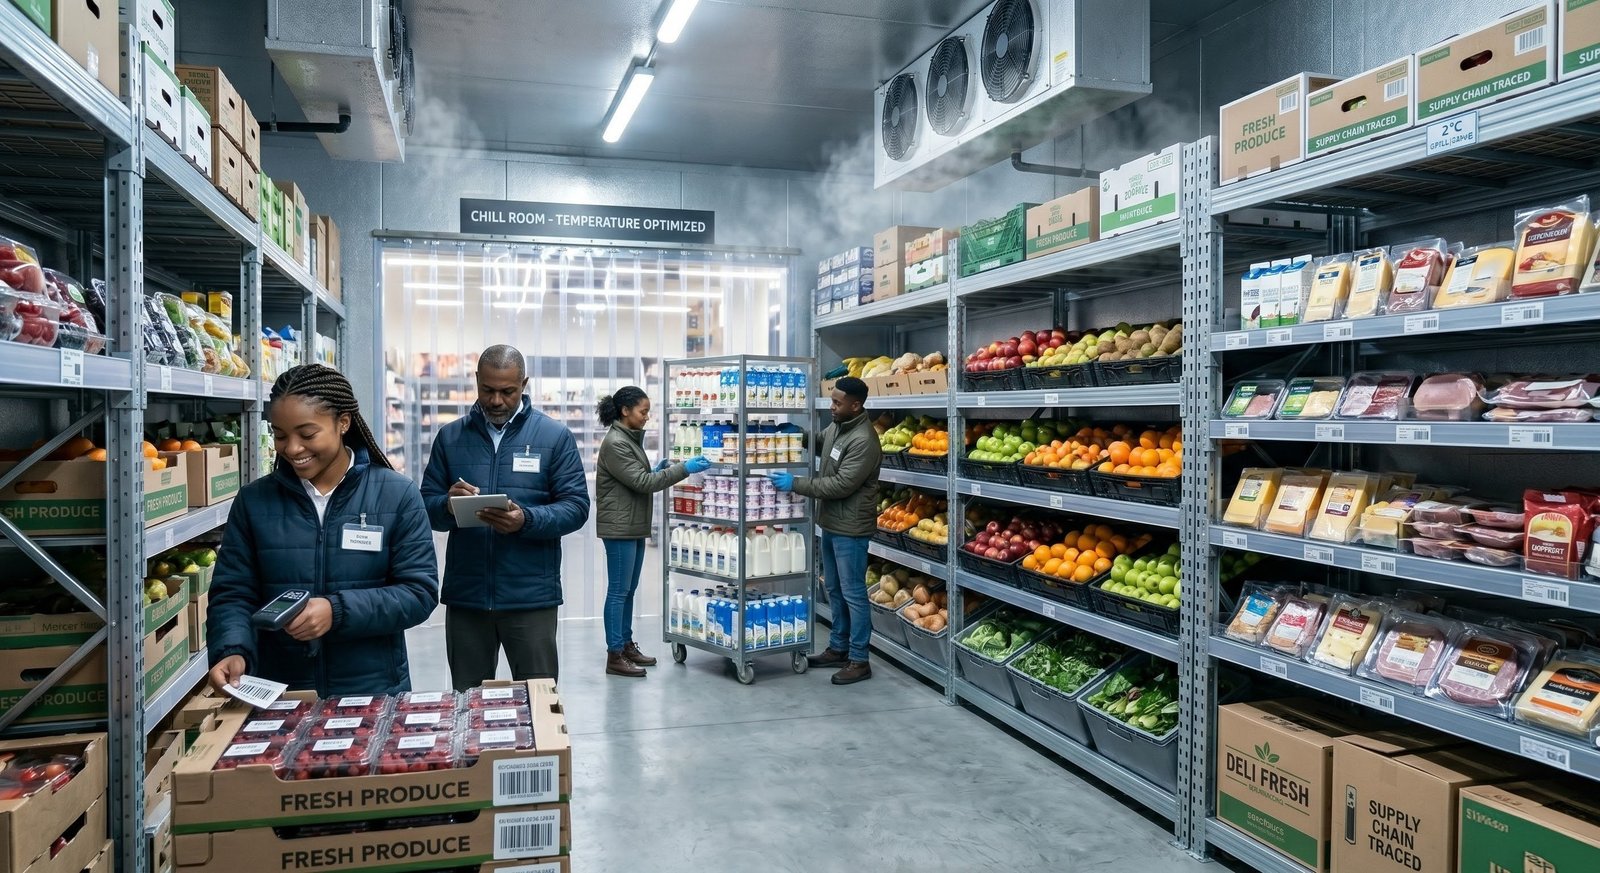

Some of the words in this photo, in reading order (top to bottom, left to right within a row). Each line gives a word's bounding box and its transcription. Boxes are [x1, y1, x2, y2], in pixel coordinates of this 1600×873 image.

[1429, 94, 1460, 112] SUPPLY
[1462, 85, 1490, 101] CHAIN
[1492, 71, 1531, 91] TRACED
[1242, 114, 1276, 136] FRESH
[1315, 133, 1340, 148] SUPPLY
[1341, 126, 1365, 139] CHAIN
[1366, 115, 1397, 131] TRACED
[1441, 121, 1463, 137] 2°C
[1234, 126, 1286, 154] PRODUCE
[470, 210, 505, 223] CHILL
[509, 211, 545, 225] ROOM
[556, 214, 640, 229] TEMPERATURE
[643, 219, 706, 233] OPTIMIZED
[1052, 228, 1078, 243] PRODUCE
[29, 506, 99, 519] PRODUCE
[146, 497, 162, 513] FRESH
[162, 491, 183, 507] PRODUCE
[42, 623, 78, 631] Mercer
[1226, 752, 1256, 783] DELI
[1260, 767, 1309, 808] FRESH
[281, 790, 353, 812] FRESH
[361, 781, 470, 805] PRODUCE
[1369, 800, 1421, 833] SUPPLY
[1372, 819, 1414, 850] CHAIN
[281, 847, 354, 870] FRESH
[362, 836, 471, 862] PRODUCE
[1368, 834, 1422, 872] TRACED
